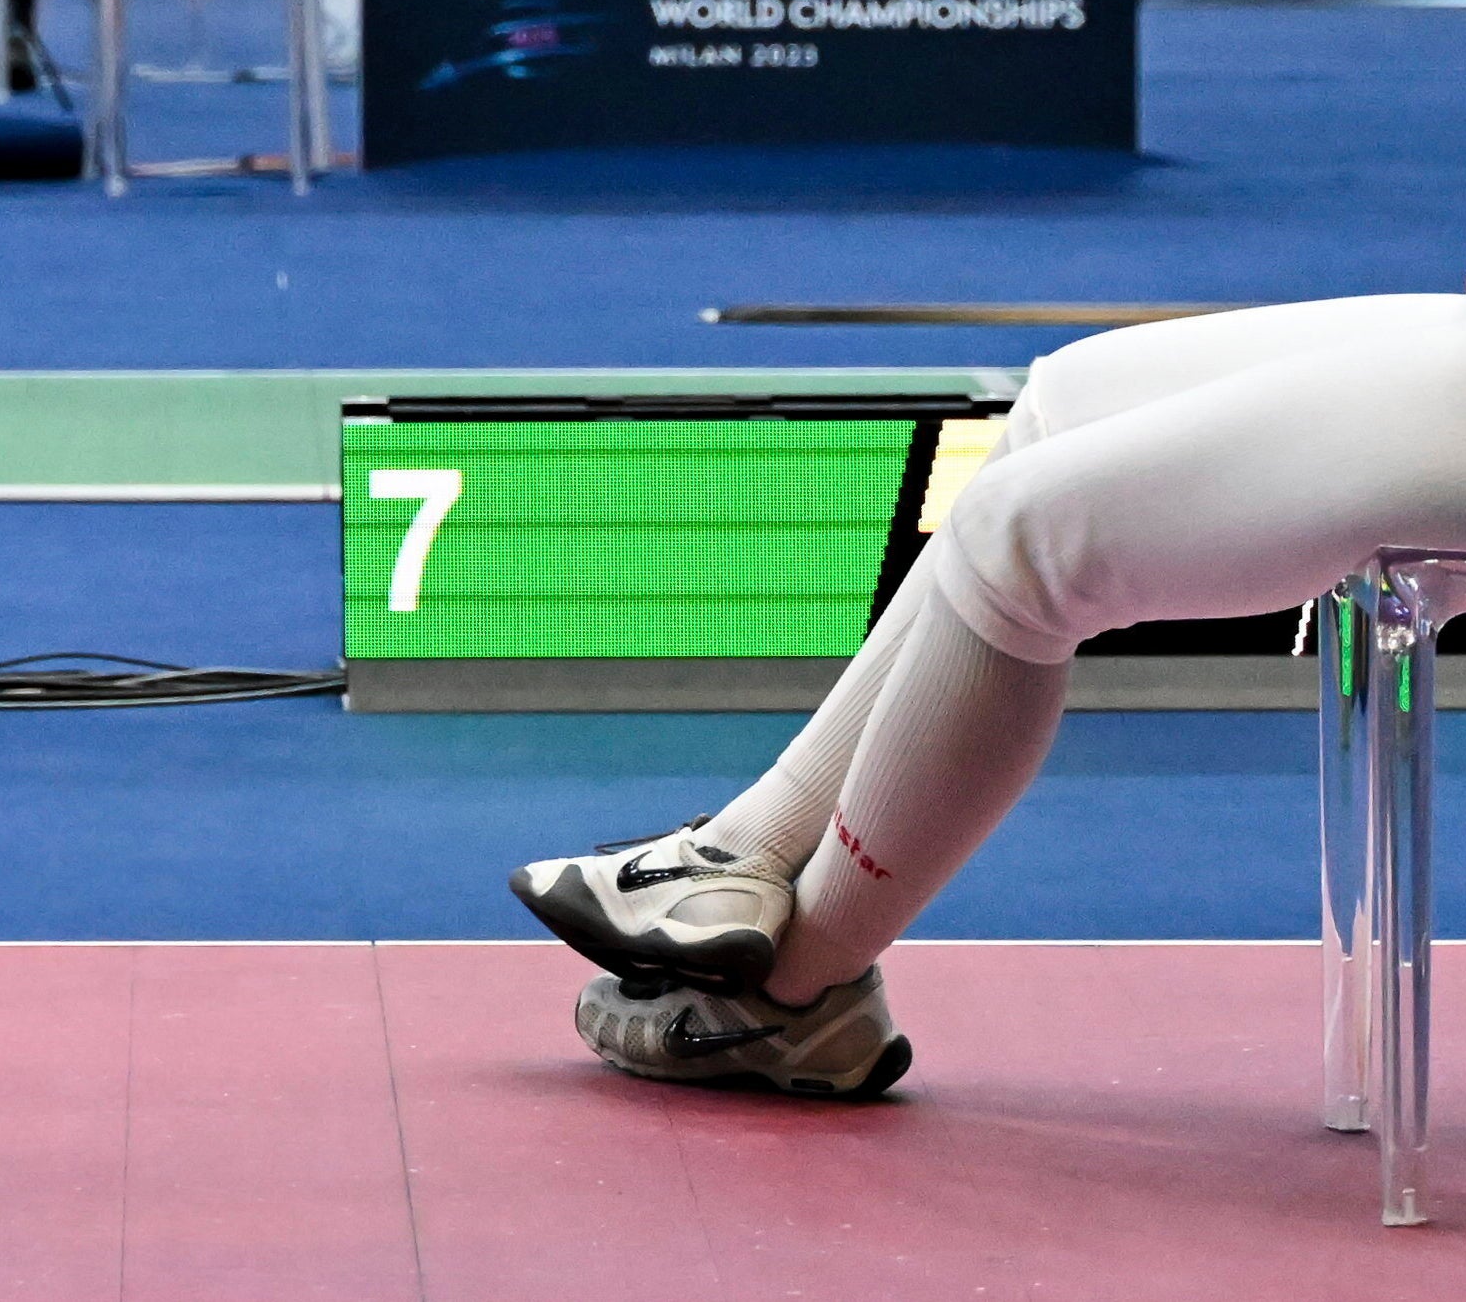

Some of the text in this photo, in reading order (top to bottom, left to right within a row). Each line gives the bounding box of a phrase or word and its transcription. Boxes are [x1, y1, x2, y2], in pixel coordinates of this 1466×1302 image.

[648, 42, 819, 68] MILAN 2023
[368, 469, 463, 612] 7
